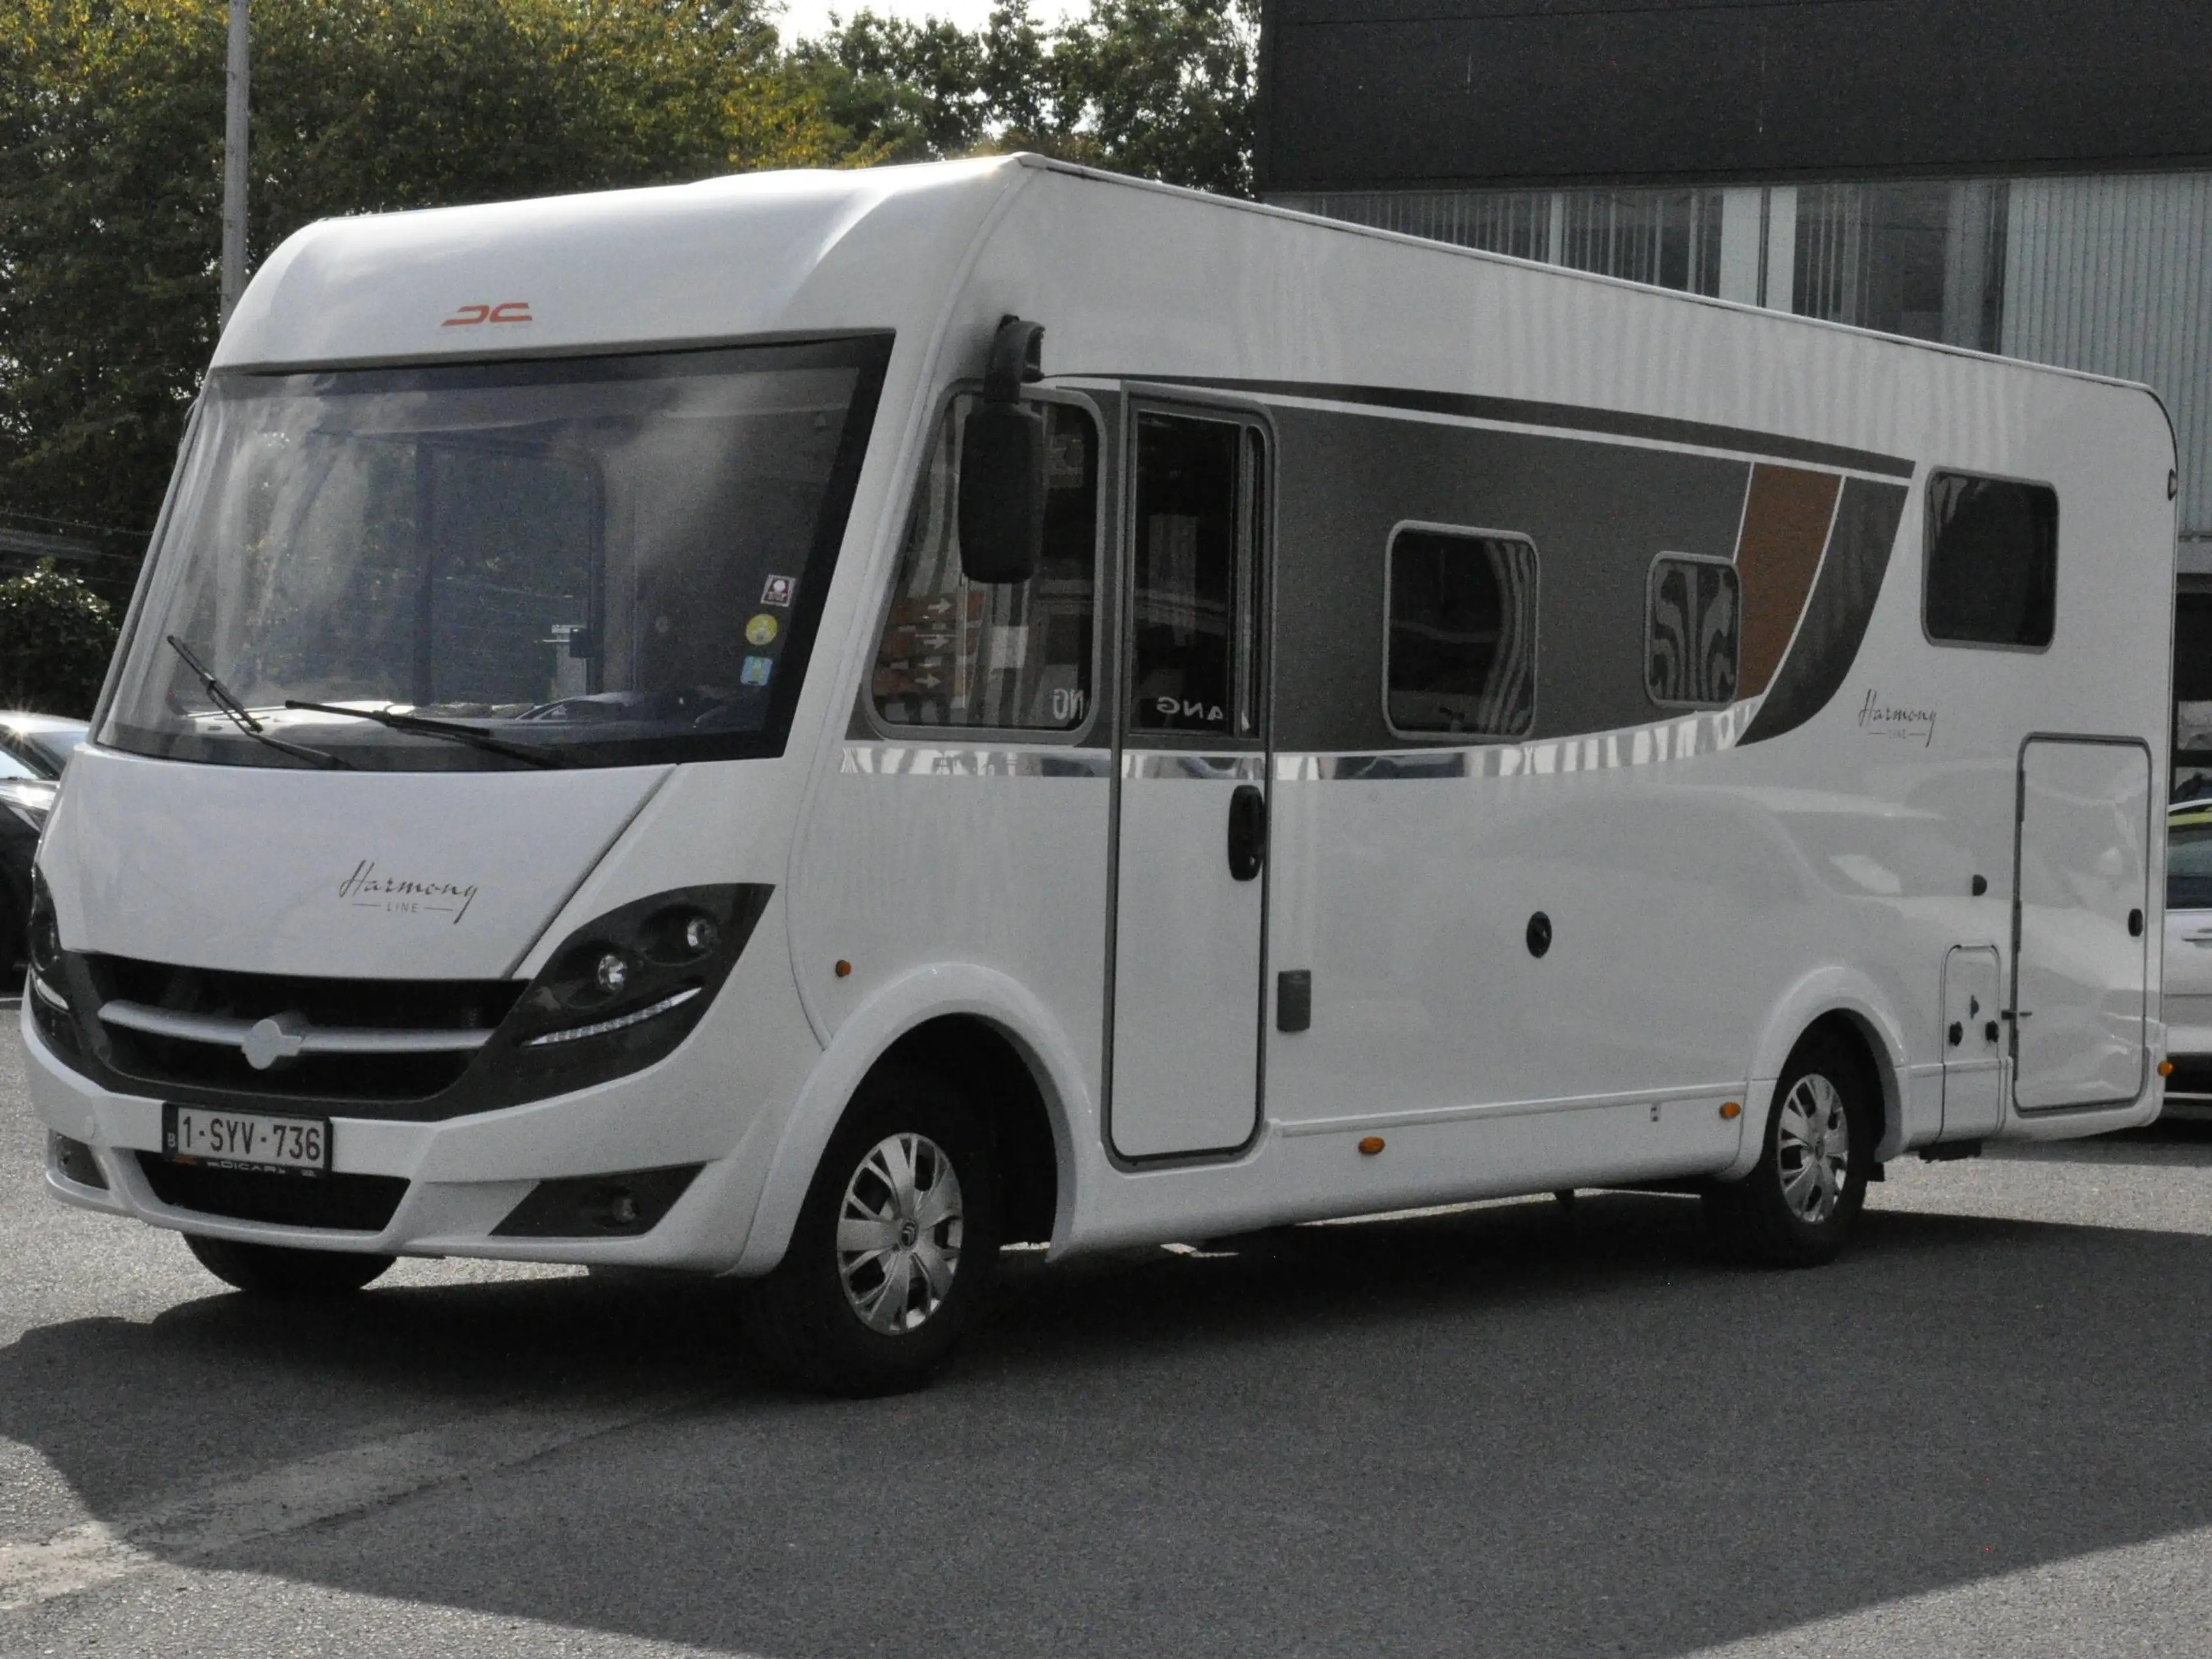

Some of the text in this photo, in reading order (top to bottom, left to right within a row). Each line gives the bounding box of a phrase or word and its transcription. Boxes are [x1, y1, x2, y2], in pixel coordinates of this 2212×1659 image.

[1858, 688, 1937, 748] Harmony
[339, 859, 478, 925] Harmony
[387, 902, 419, 913] LINE
[183, 1116, 320, 1161] 1-SYV-736
